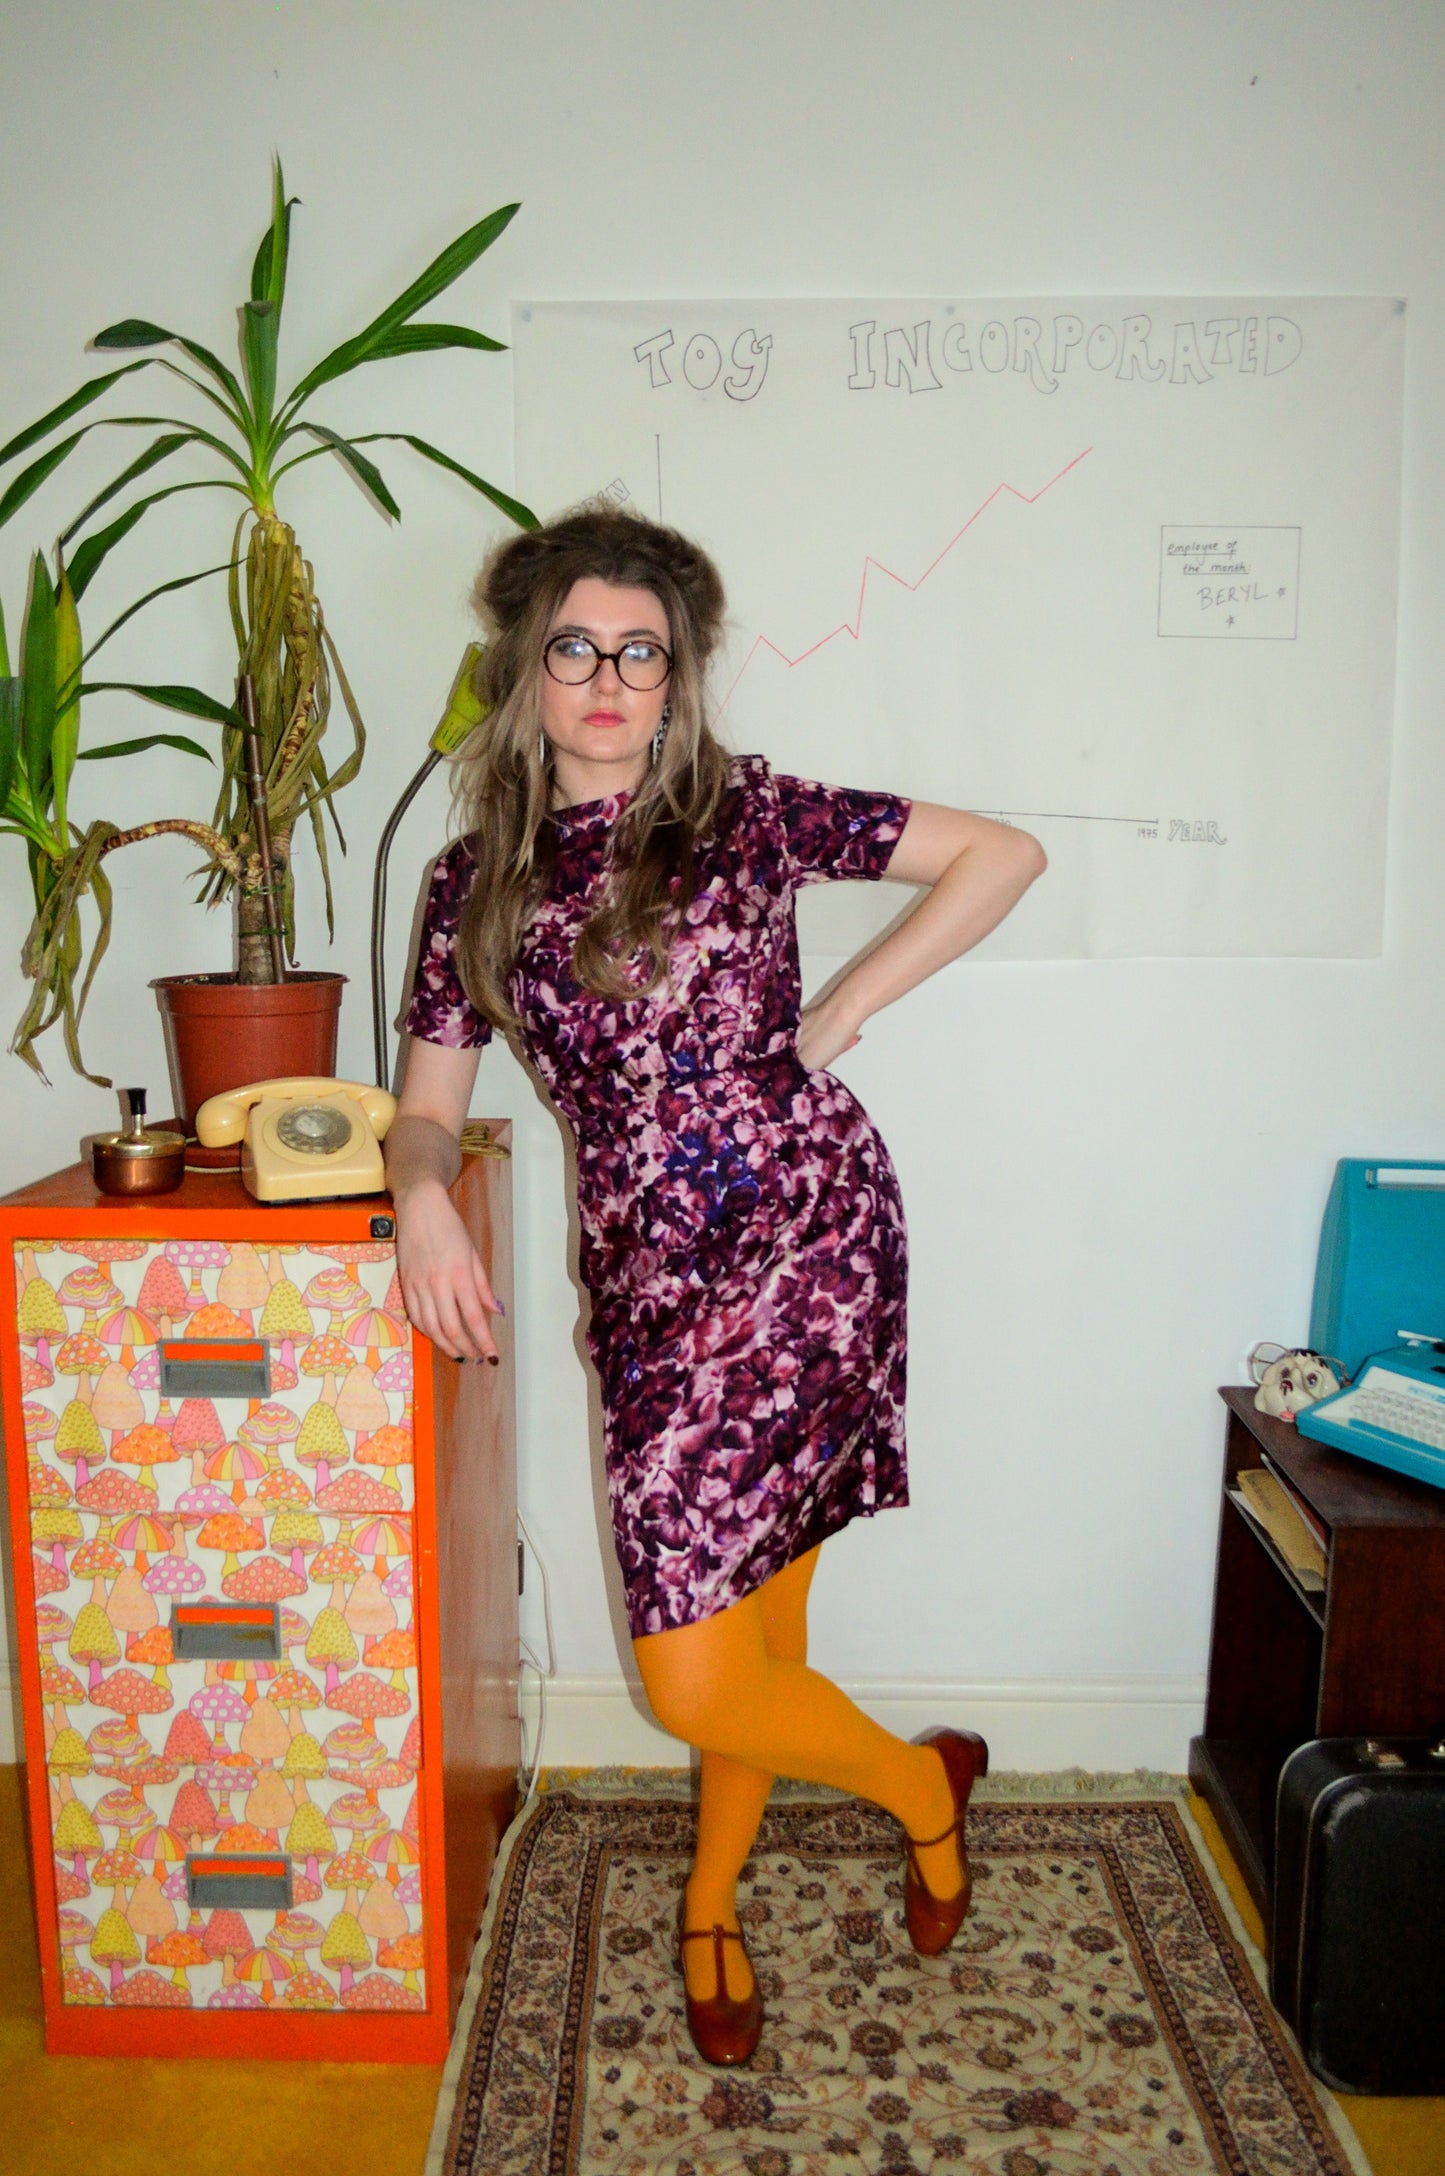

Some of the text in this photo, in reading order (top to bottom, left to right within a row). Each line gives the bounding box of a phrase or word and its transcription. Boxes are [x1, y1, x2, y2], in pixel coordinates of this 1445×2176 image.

[848, 314, 1303, 394] INCORPORATED
[1167, 540, 1238, 565] employee of
[1183, 563, 1200, 573] the
[1197, 583, 1269, 611] BERYL
[1137, 819, 1228, 845] 1975 YEAR
